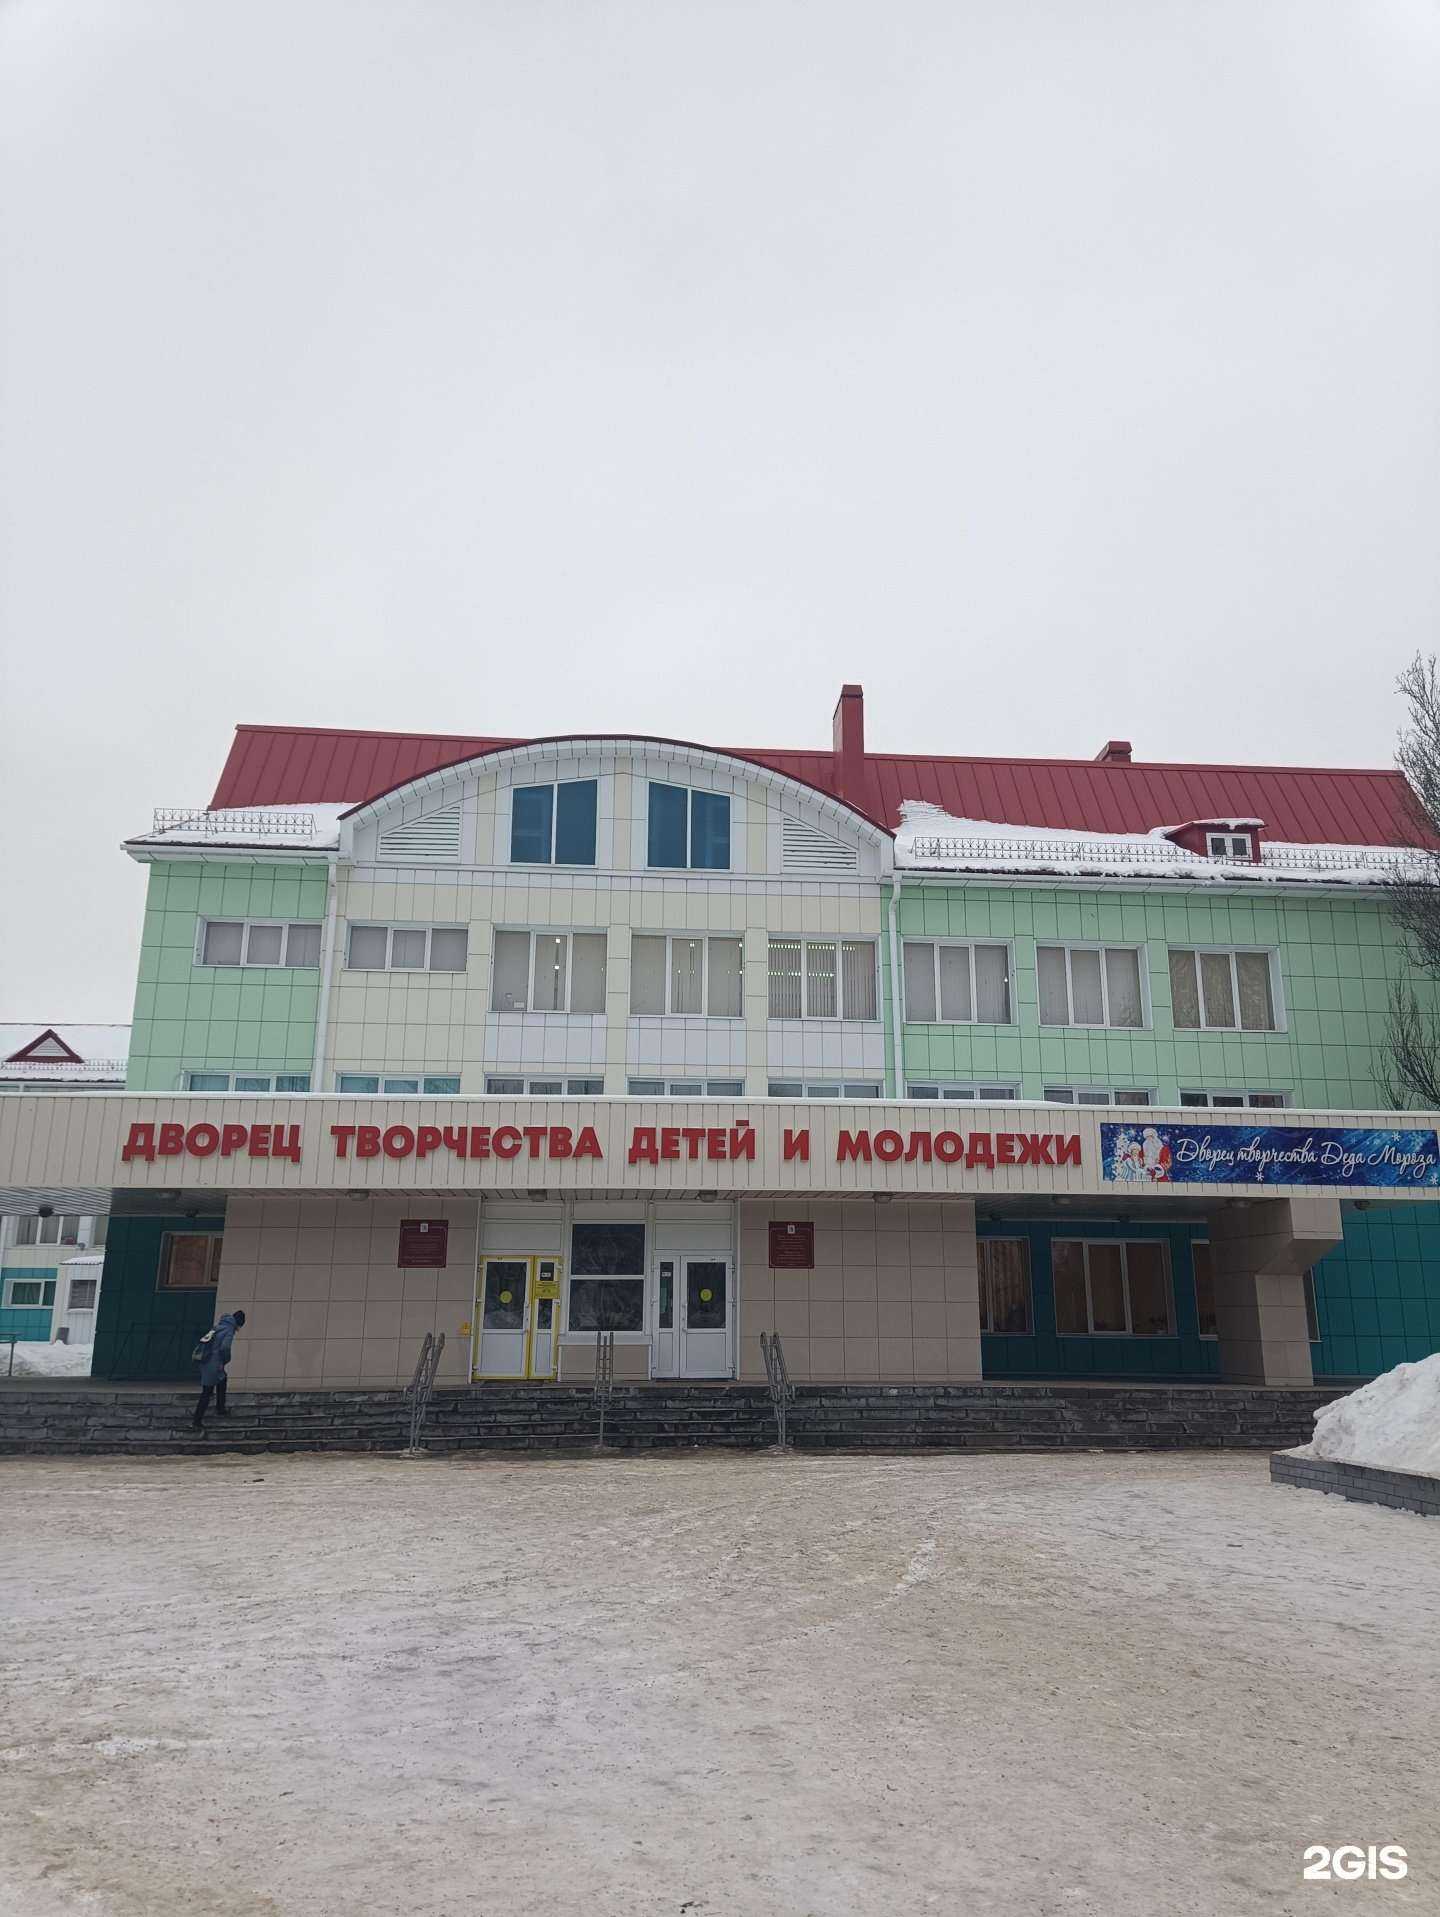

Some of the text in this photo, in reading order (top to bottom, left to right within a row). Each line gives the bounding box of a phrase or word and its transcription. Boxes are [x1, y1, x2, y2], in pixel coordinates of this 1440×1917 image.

[122, 1119, 1082, 1169] ДВОРЕЦ ТВОРЧЕСТВА ДЕТЕЙ И МОЛОДЕЖИ
[1176, 1136, 1437, 1179] Дворец творчества Деда Мороза
